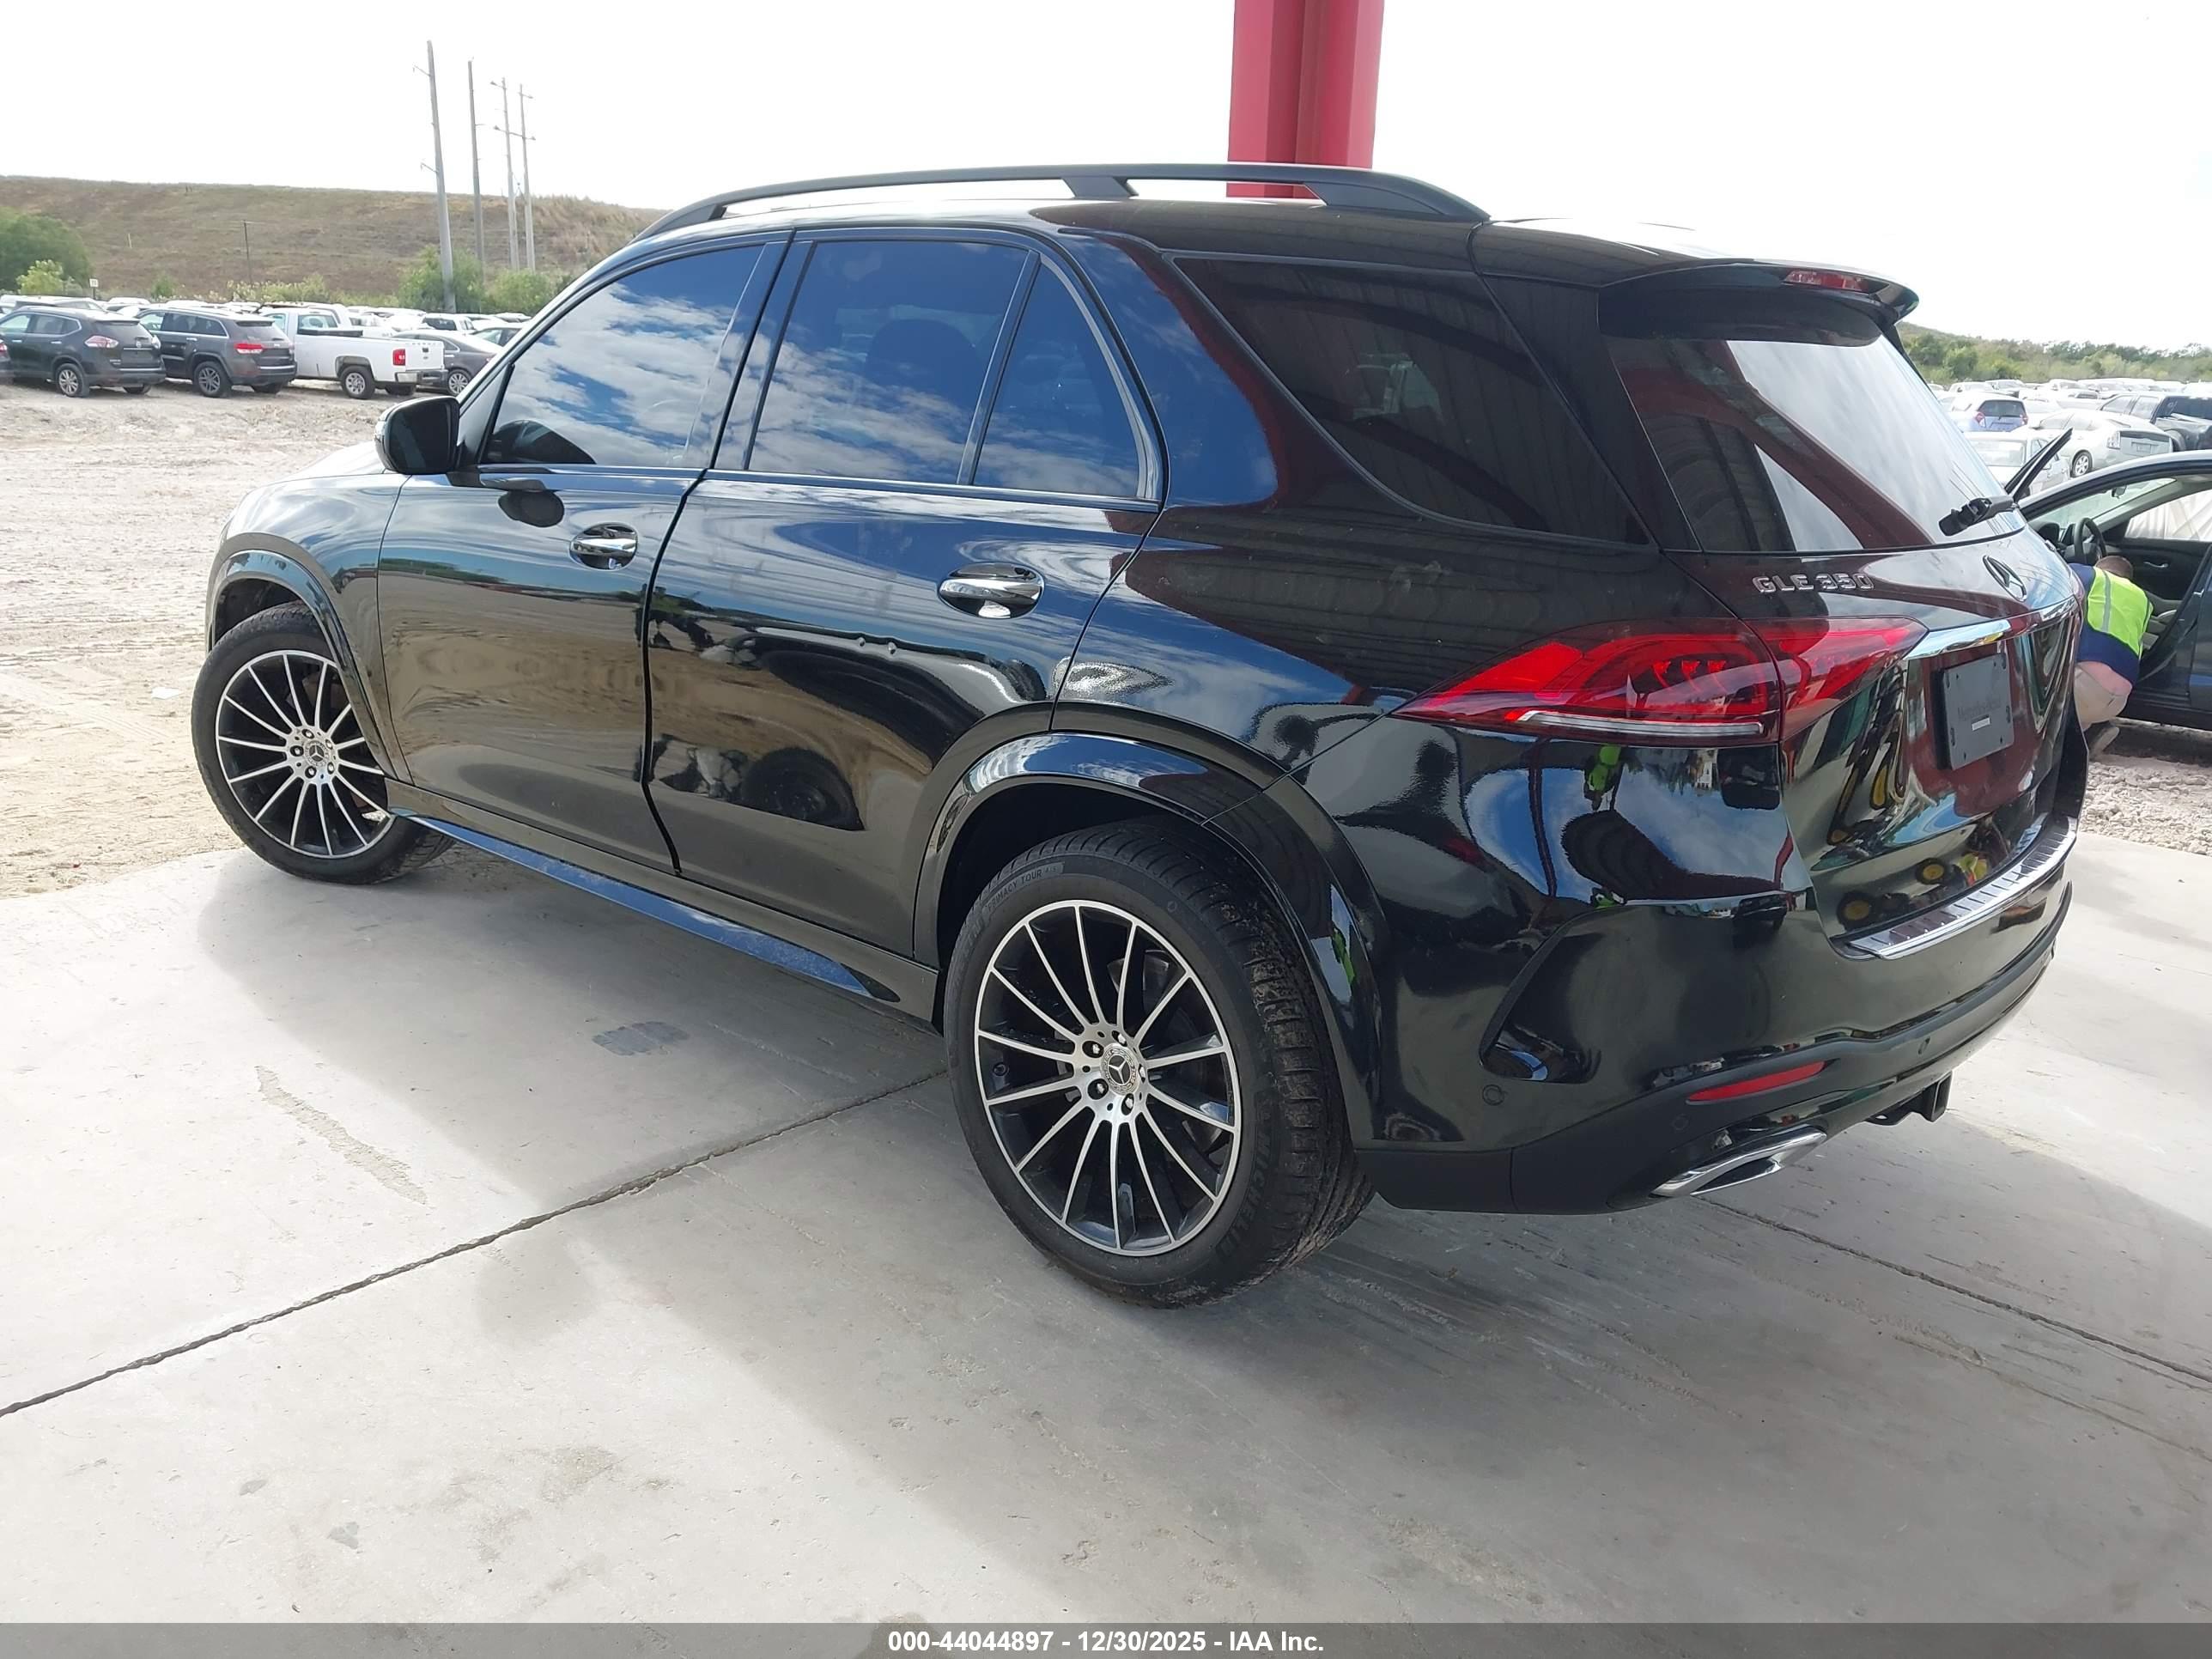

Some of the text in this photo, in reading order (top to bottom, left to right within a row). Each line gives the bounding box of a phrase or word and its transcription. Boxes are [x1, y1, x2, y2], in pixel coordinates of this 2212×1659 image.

[1752, 573, 1875, 592] GLE 350
[989, 880, 1018, 909] PRIMACY
[1022, 870, 1042, 884] TOUR
